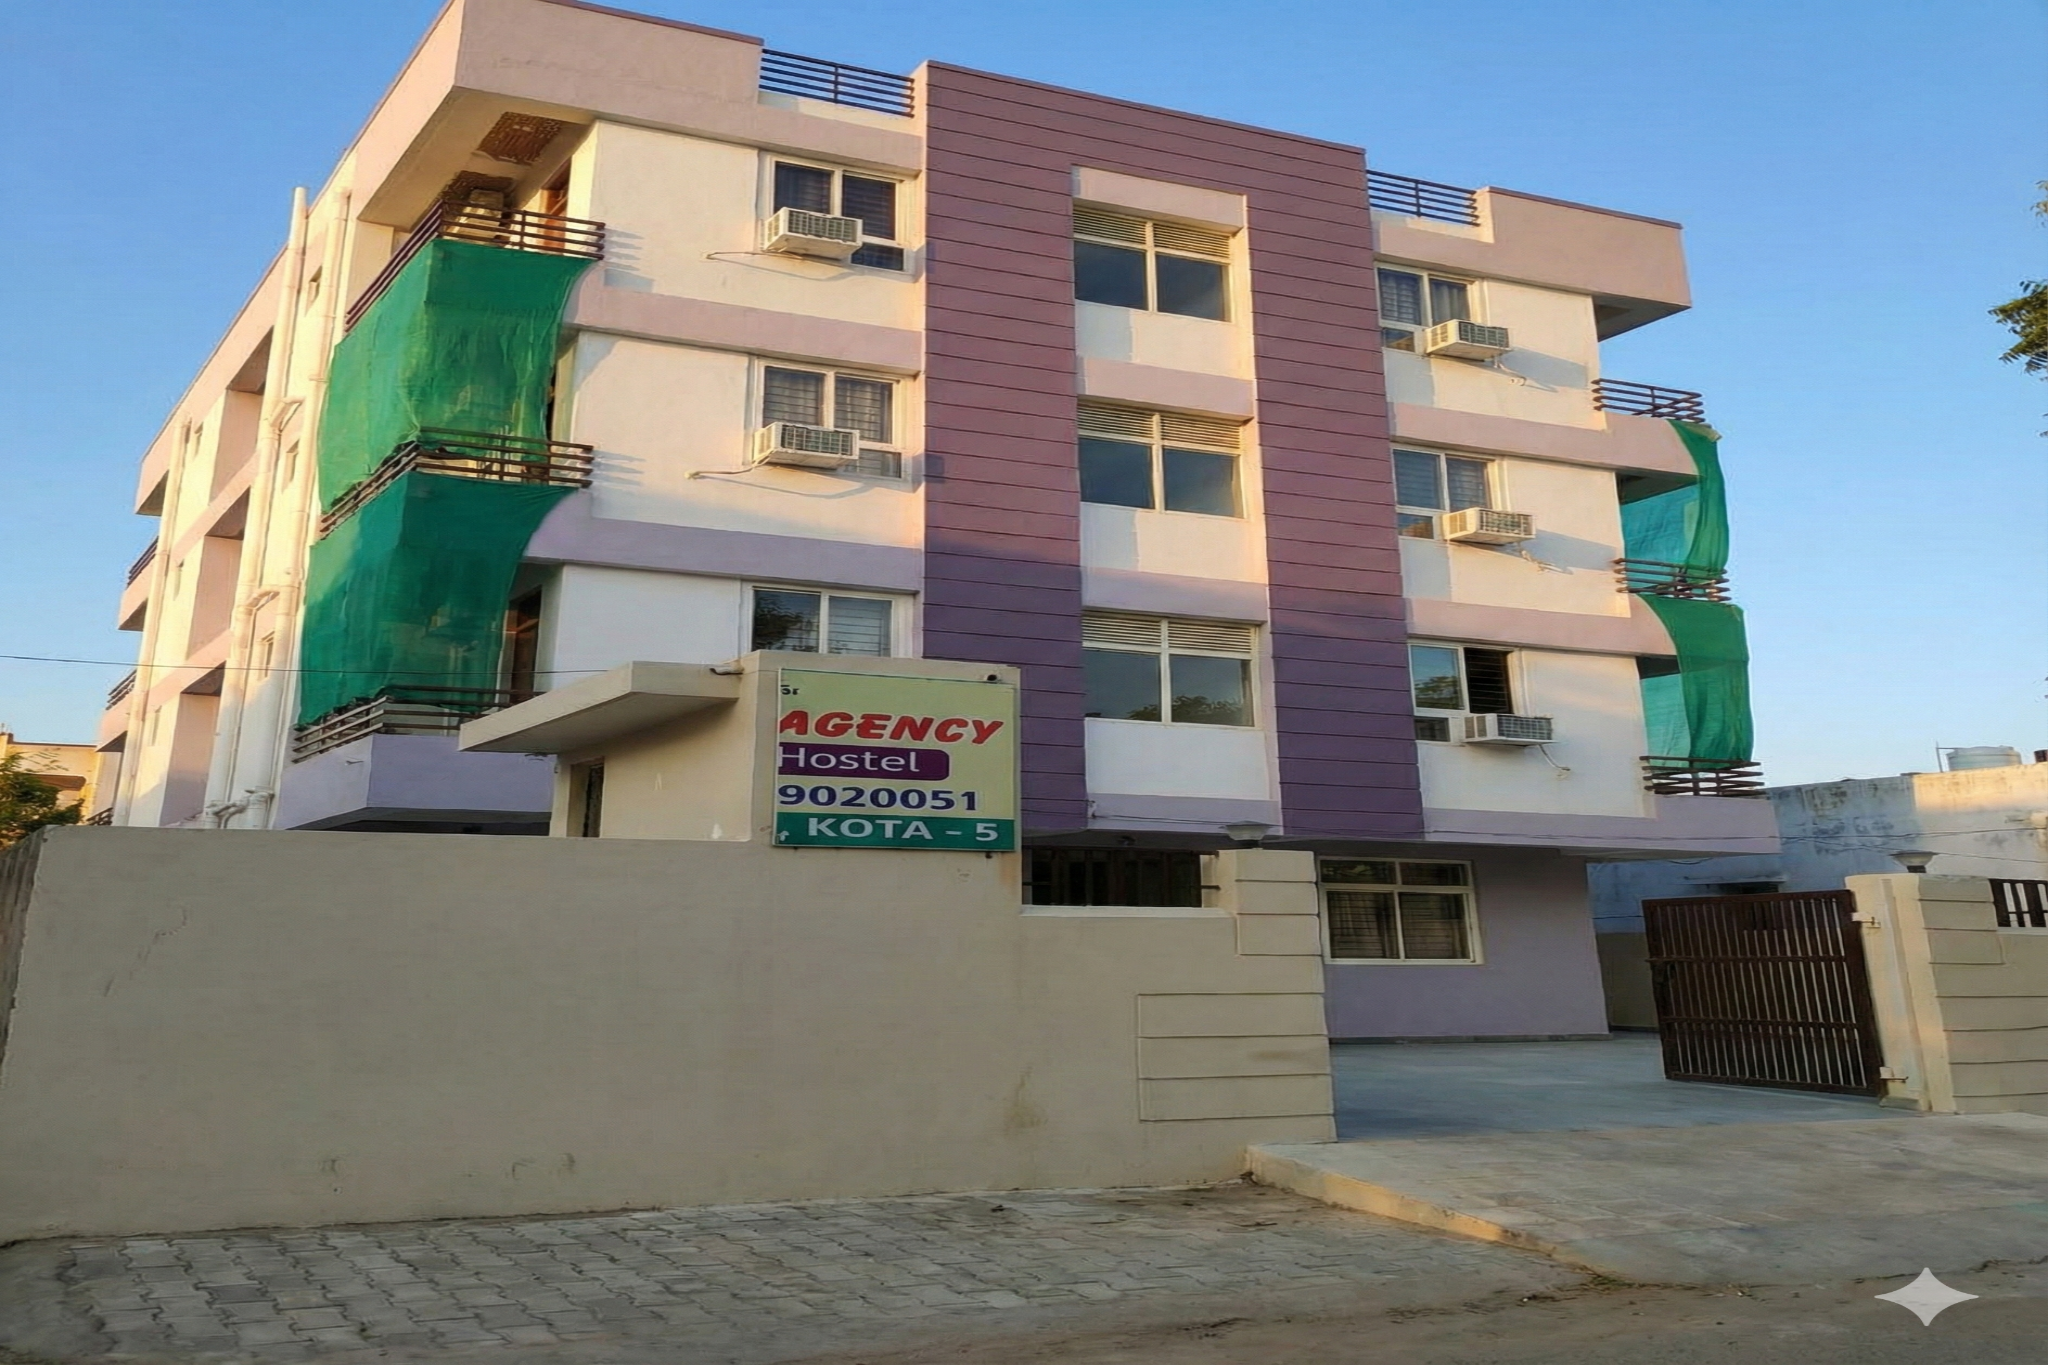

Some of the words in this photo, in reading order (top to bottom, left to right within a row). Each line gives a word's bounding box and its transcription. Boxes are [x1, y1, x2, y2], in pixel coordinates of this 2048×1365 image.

[779, 710, 1004, 744] AGENCY
[778, 746, 920, 773] Hostel
[778, 784, 977, 811] 9020051
[807, 817, 934, 841] KOTA
[975, 822, 999, 841] 5
